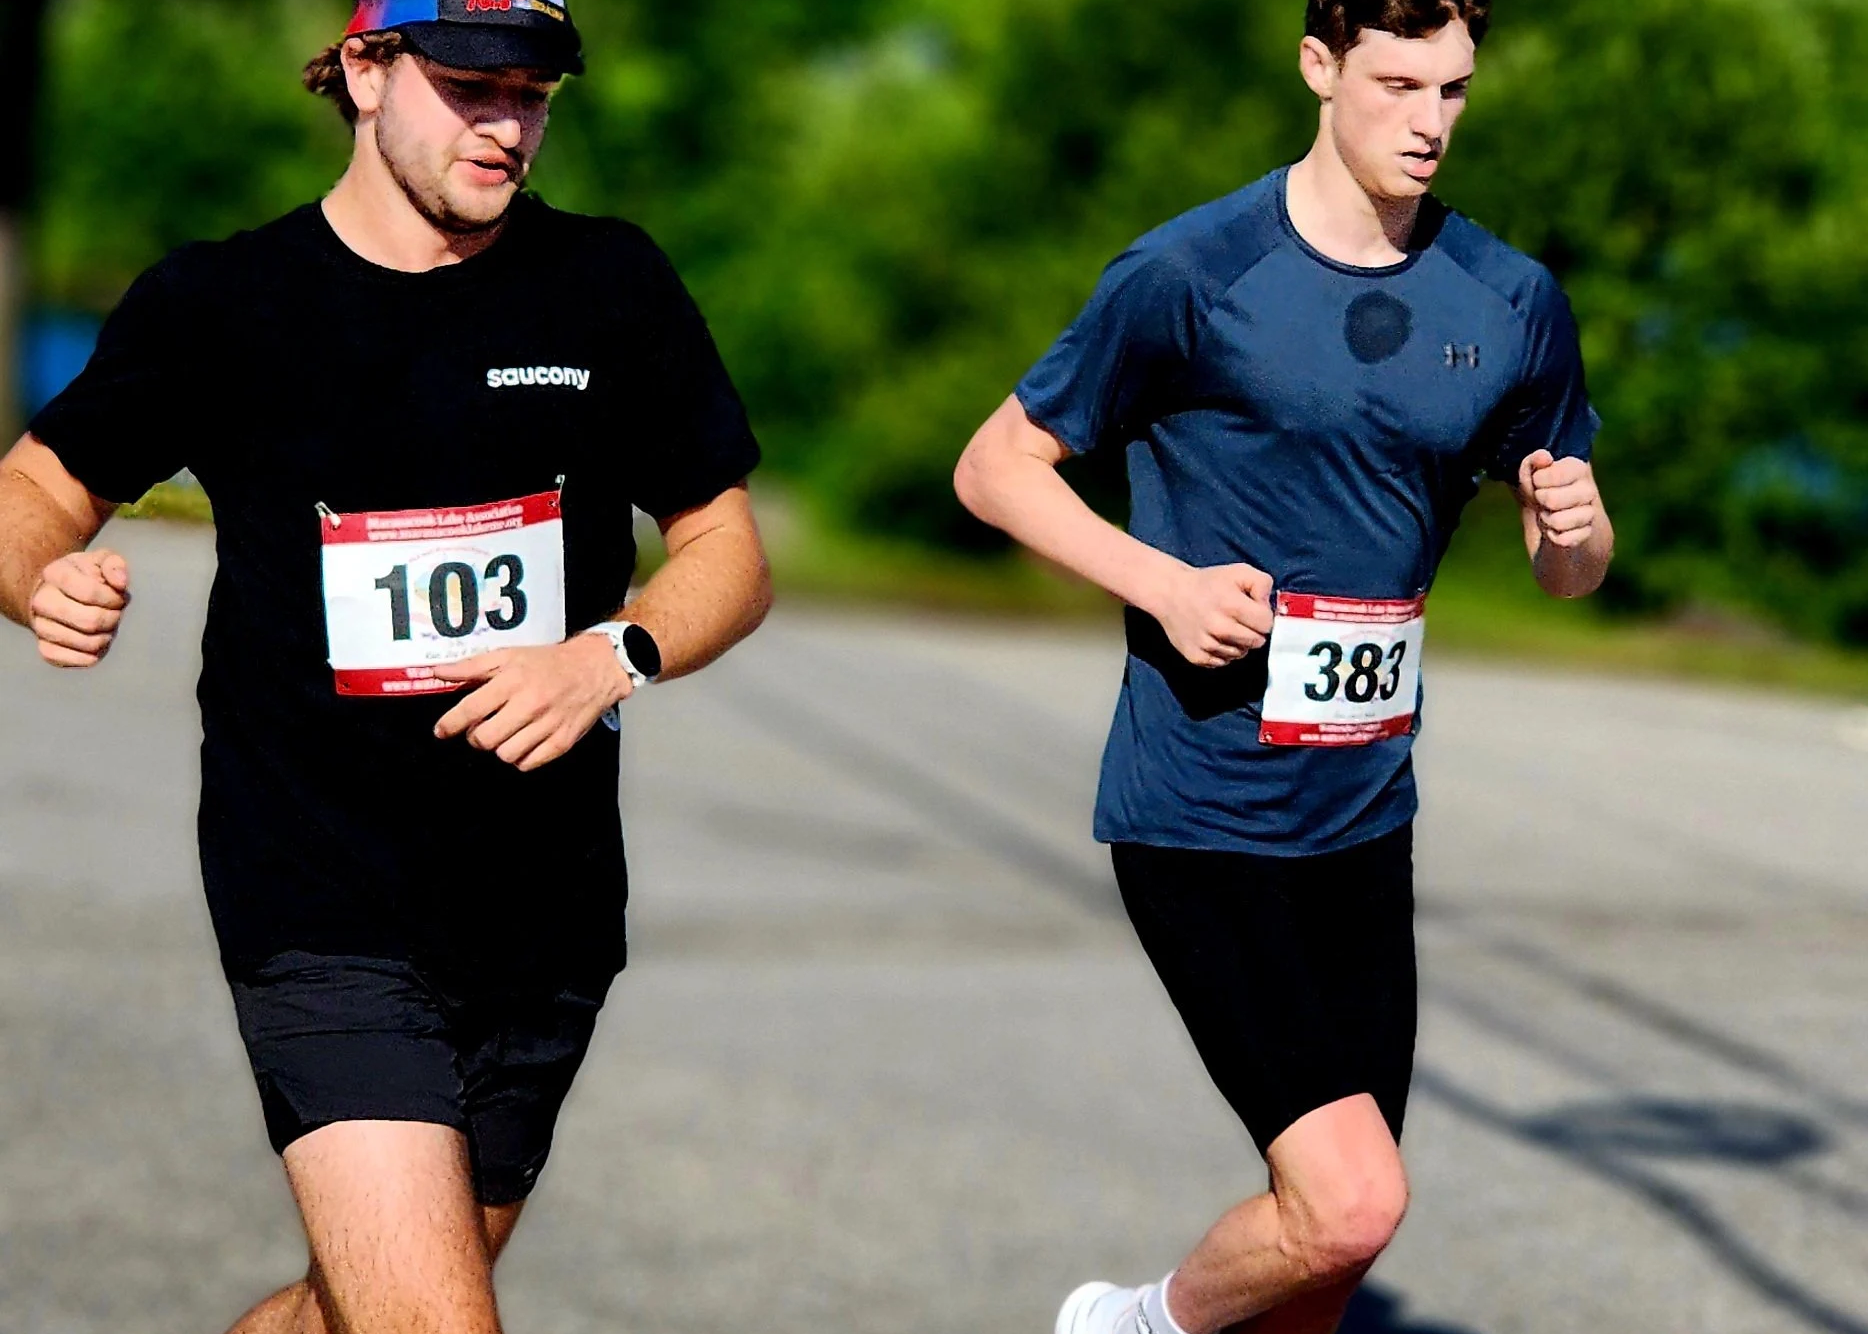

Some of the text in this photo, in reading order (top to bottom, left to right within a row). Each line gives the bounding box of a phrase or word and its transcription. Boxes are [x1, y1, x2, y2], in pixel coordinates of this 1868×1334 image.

[487, 366, 590, 390] saucony
[374, 554, 528, 641] 103
[1304, 640, 1407, 703] 383
